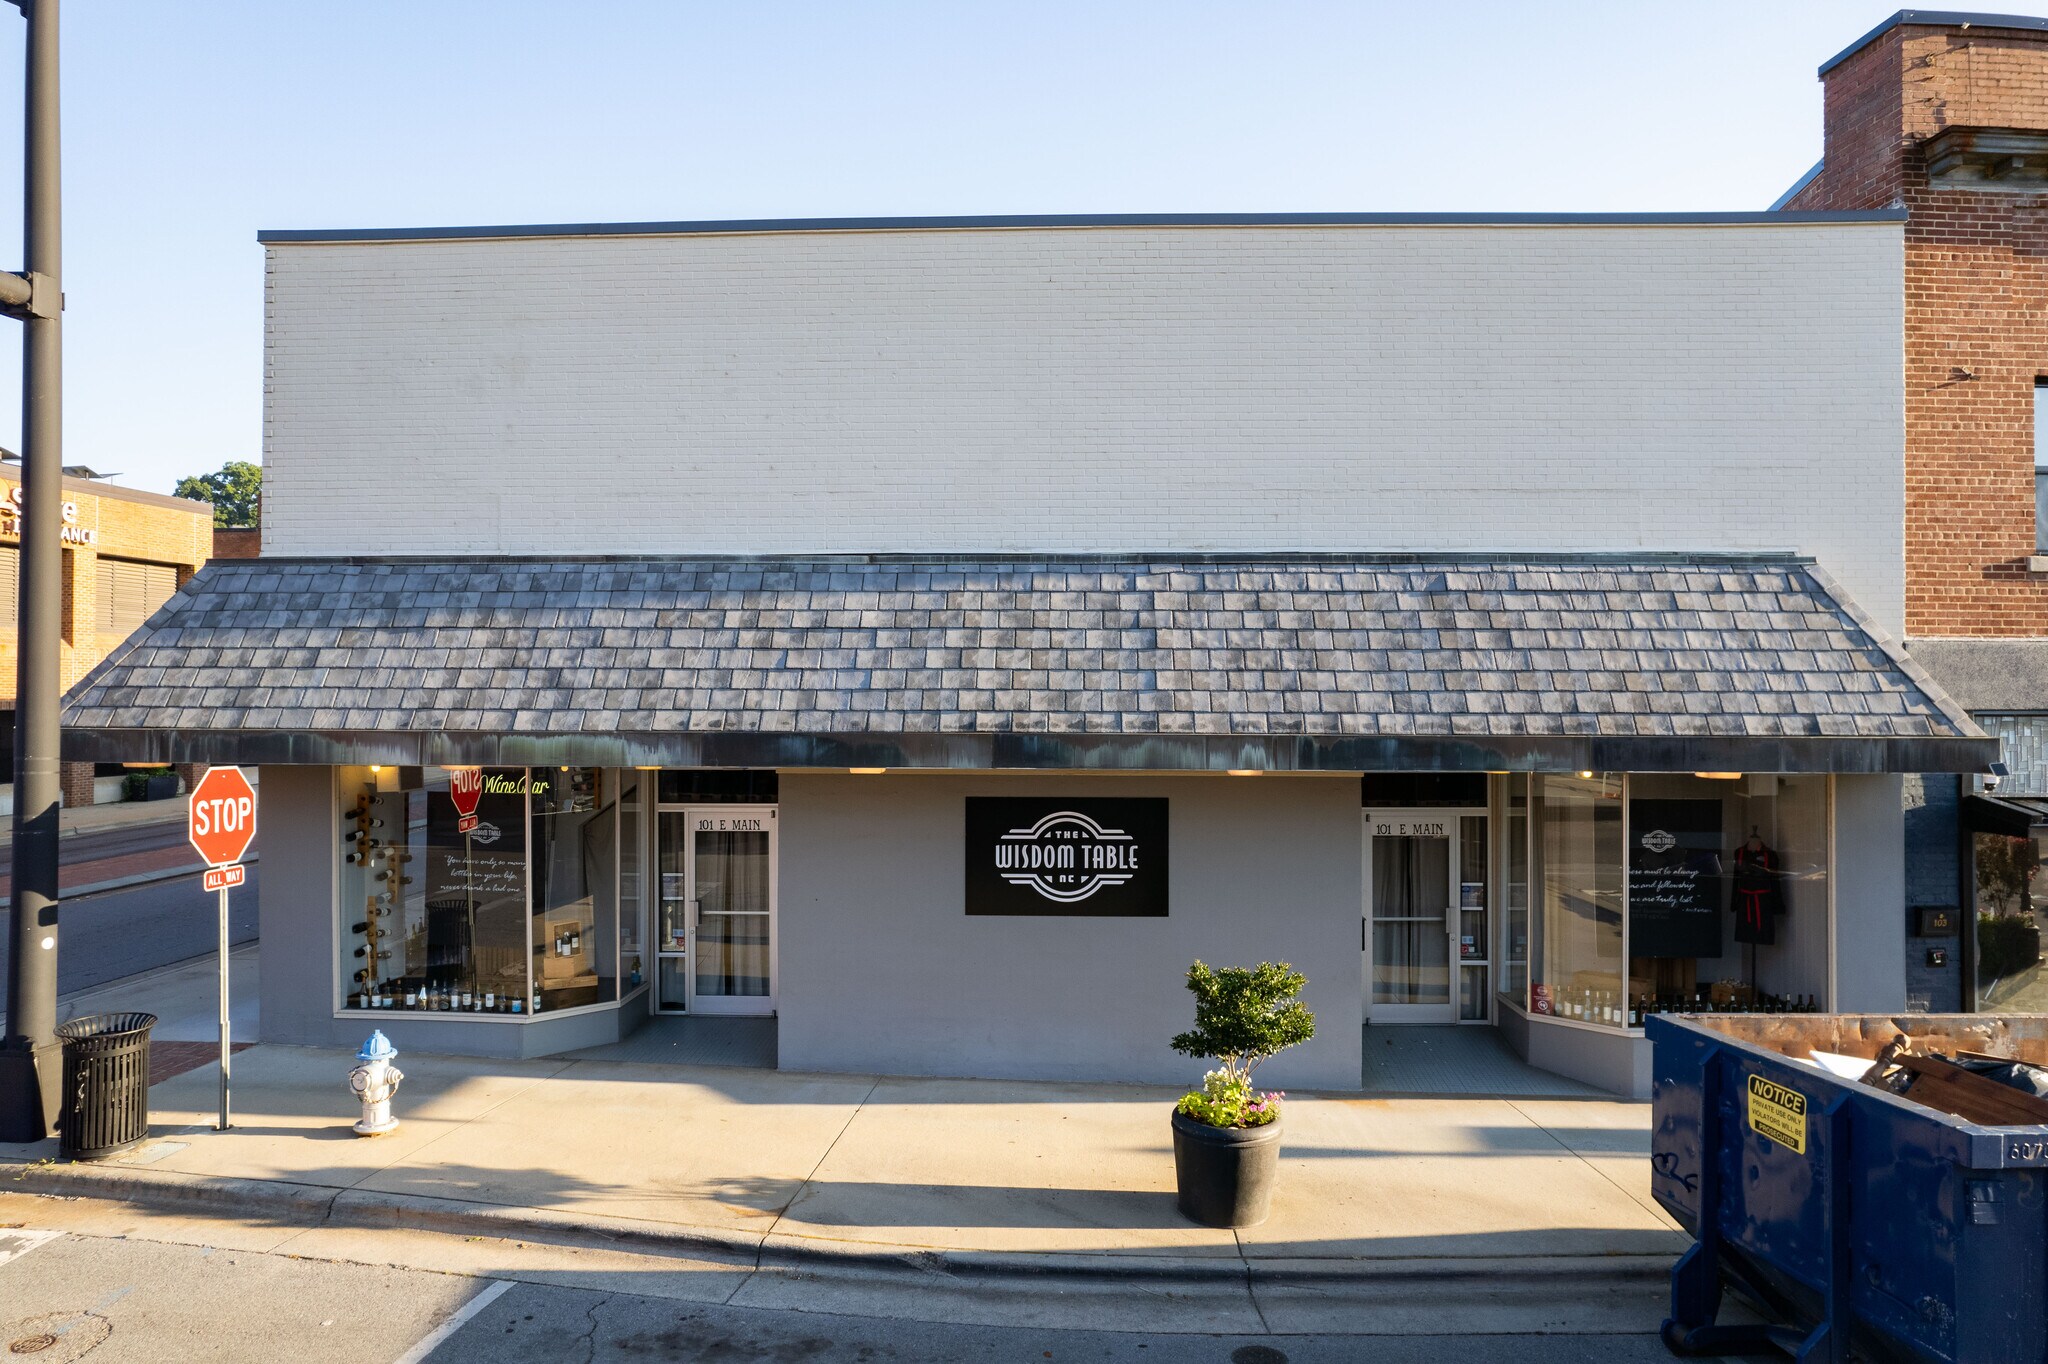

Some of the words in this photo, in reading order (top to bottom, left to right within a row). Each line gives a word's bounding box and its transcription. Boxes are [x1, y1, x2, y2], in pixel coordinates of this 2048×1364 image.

[480, 774, 516, 794] Wine
[195, 797, 252, 836] STOP
[699, 819, 714, 831] 101
[720, 819, 727, 831] E
[732, 819, 761, 831] MAIN
[1055, 831, 1079, 839] THE
[1376, 823, 1391, 835] 101
[1400, 823, 1406, 834] E
[1413, 823, 1444, 835] MAIN
[995, 844, 1075, 869] WISDOM
[1081, 845, 1139, 869] TABLE
[208, 874, 222, 886] ALL
[225, 870, 241, 881] WAY
[1059, 874, 1075, 883] NC
[1934, 918, 1948, 927] 103
[1754, 1080, 1802, 1112] NOTICE
[1752, 1098, 1775, 1114] PRIVATE
[1775, 1109, 1786, 1119] USE
[1786, 1114, 1801, 1126] ONLY
[1751, 1108, 1781, 1127] VIOLATORS
[1781, 1122, 1794, 1134] WILL
[1794, 1129, 1802, 1137] BE
[1758, 1123, 1795, 1146] PROSECUTED
